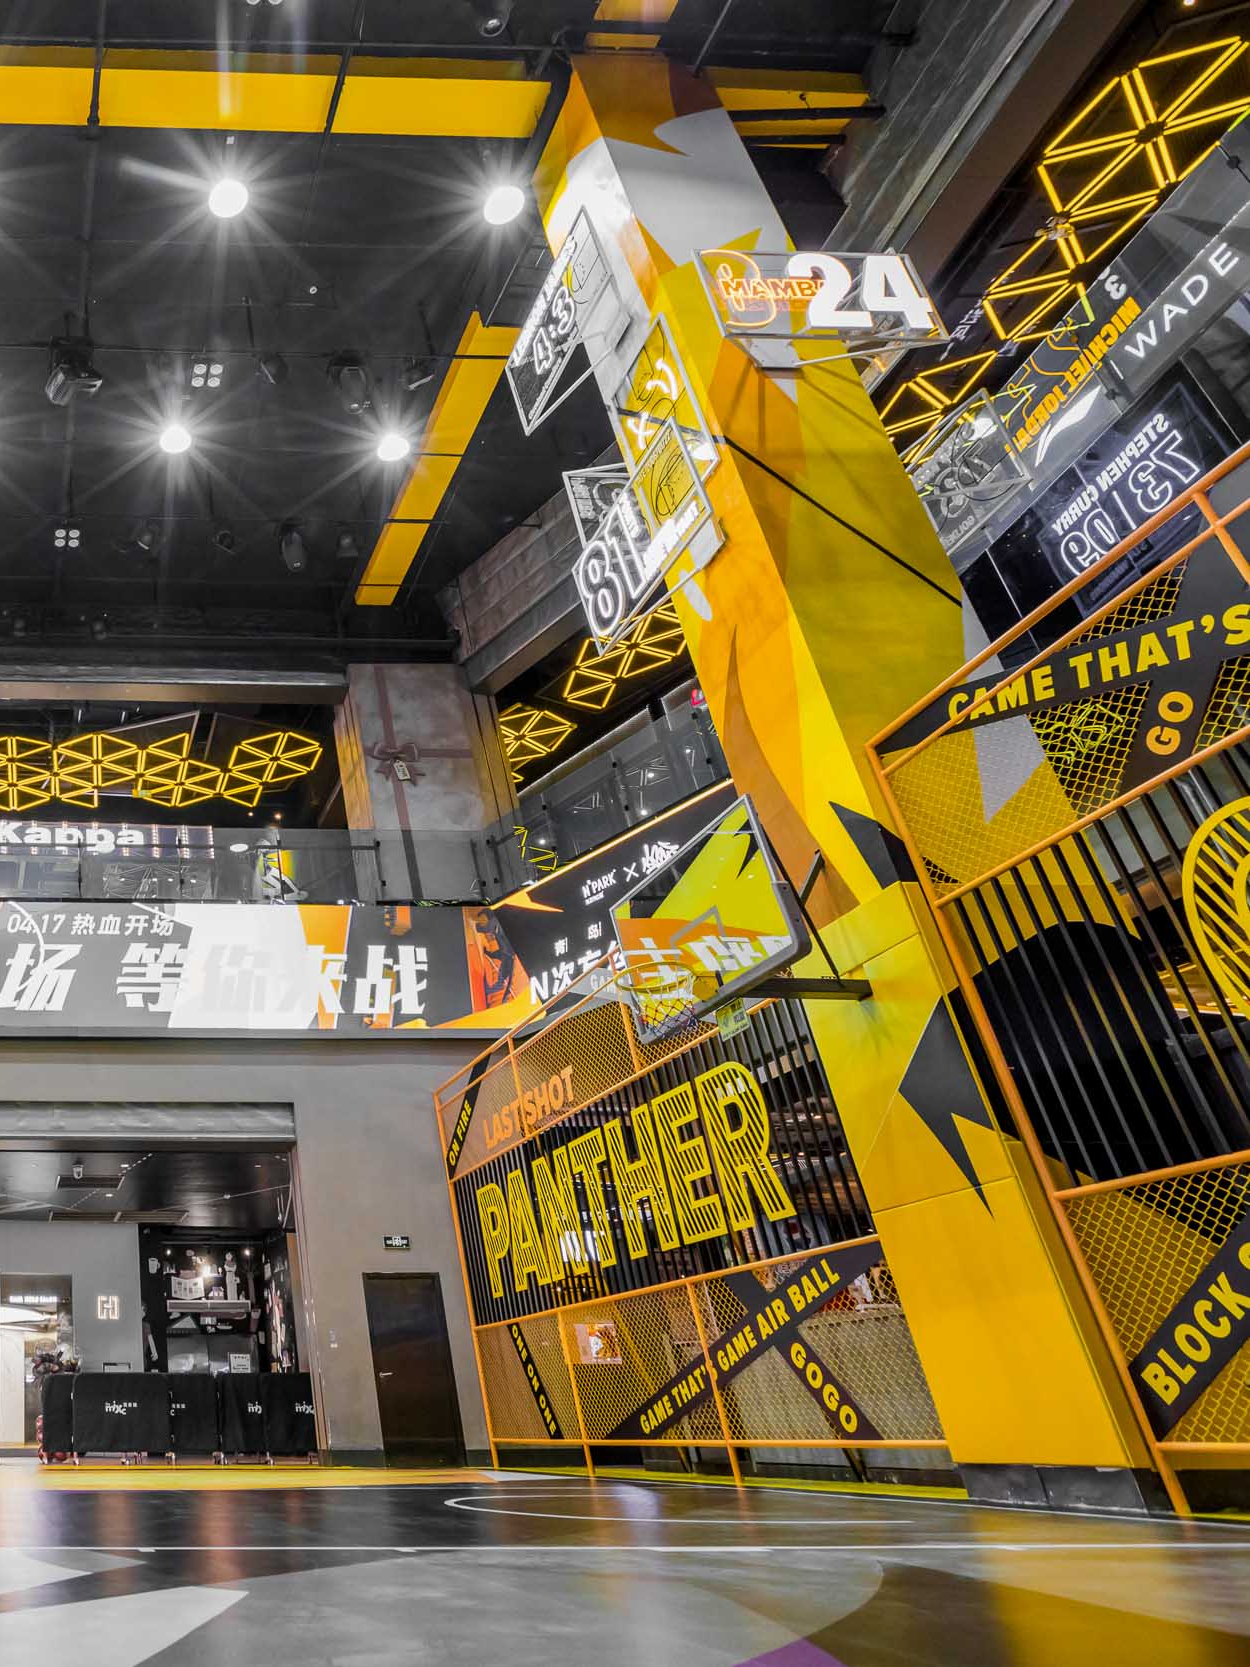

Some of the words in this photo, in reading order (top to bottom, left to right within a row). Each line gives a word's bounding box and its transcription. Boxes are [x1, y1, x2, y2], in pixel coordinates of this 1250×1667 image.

[718, 278, 826, 300] MAMB
[787, 252, 934, 329] 24
[1124, 242, 1239, 359] WADE
[1146, 691, 1194, 756] GO
[6, 912, 67, 932] 04.17
[71, 912, 176, 936] 热血开场
[116, 942, 429, 1015] 等你来战
[449, 1139, 460, 1166] ON
[456, 1099, 472, 1141] FIRE
[483, 1100, 521, 1149] LAST
[524, 1064, 574, 1126] SHOT
[476, 1061, 797, 1299] PANTHER
[640, 1395, 674, 1435] GAME
[717, 1325, 758, 1372] GAME
[756, 1298, 790, 1340] AIR
[786, 1258, 840, 1312] BALL
[1140, 1271, 1250, 1406] BLOCK
[512, 1324, 528, 1362] ONE
[528, 1363, 539, 1392] ON
[539, 1394, 557, 1435] ONE
